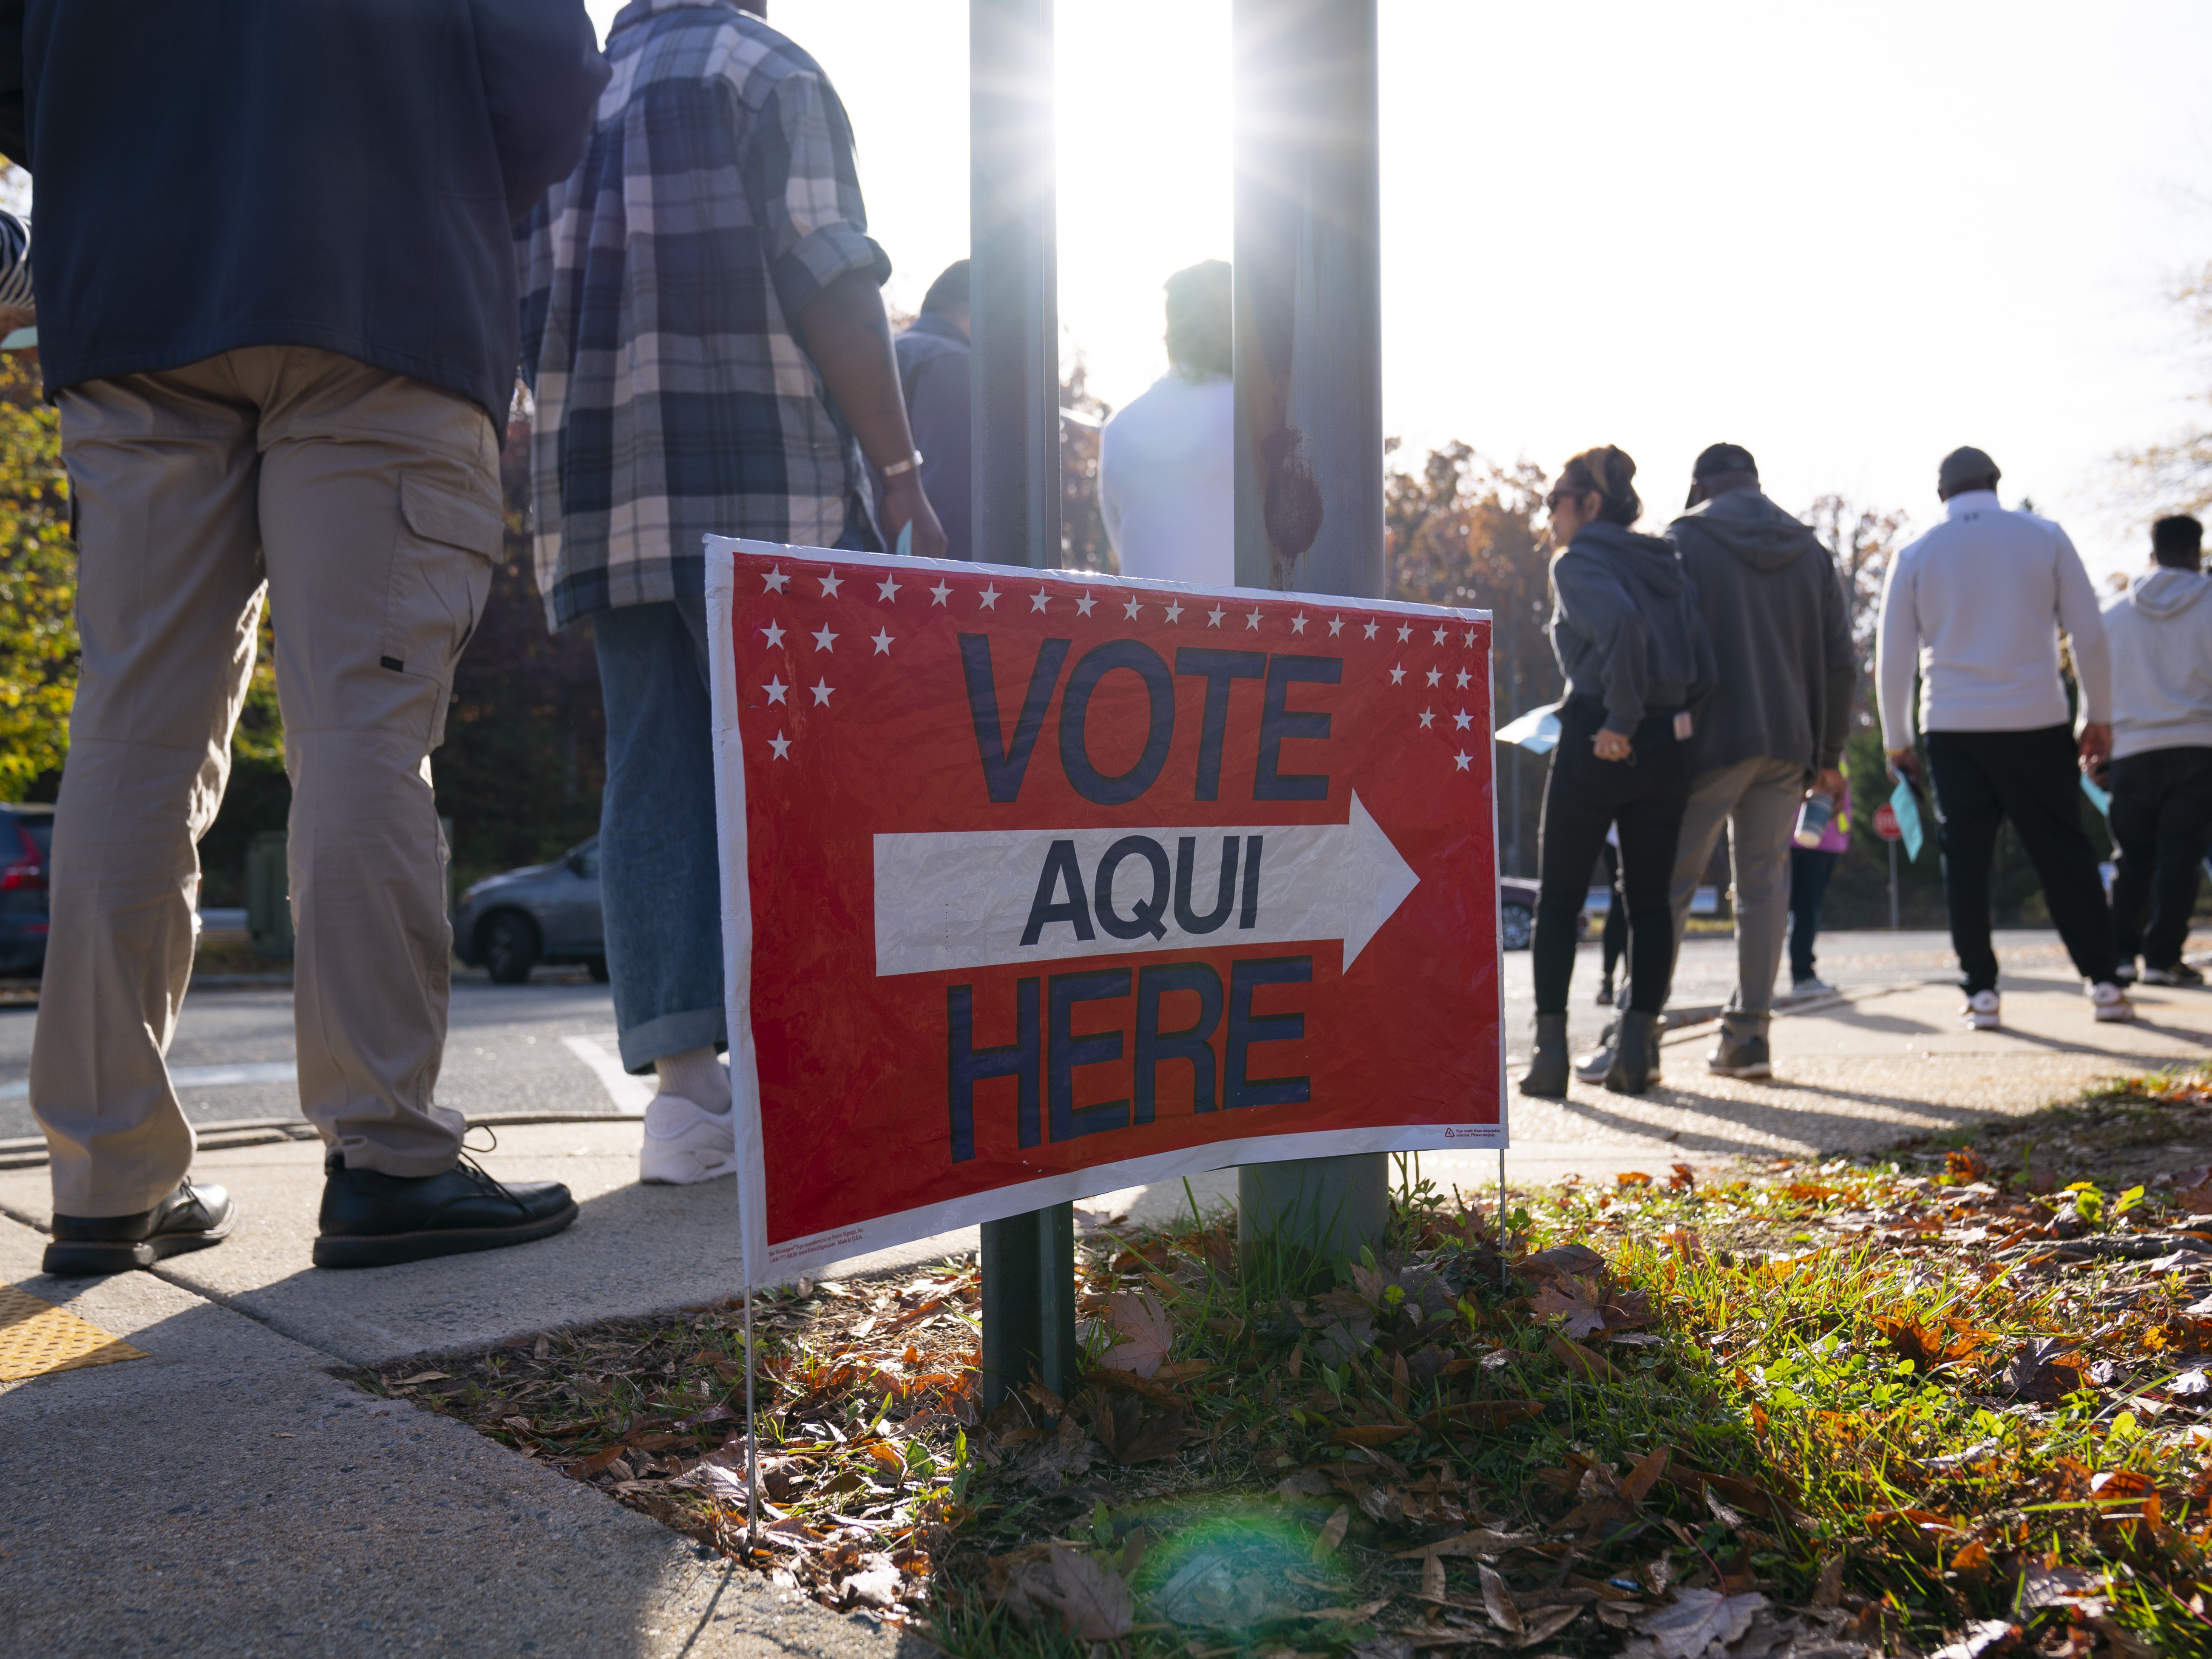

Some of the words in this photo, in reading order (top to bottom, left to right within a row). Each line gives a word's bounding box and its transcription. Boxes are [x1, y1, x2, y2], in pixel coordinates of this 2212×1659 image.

[957, 632, 1344, 805] VOTE
[1019, 835, 1264, 946] AQUI
[947, 955, 1313, 1164] HERE
